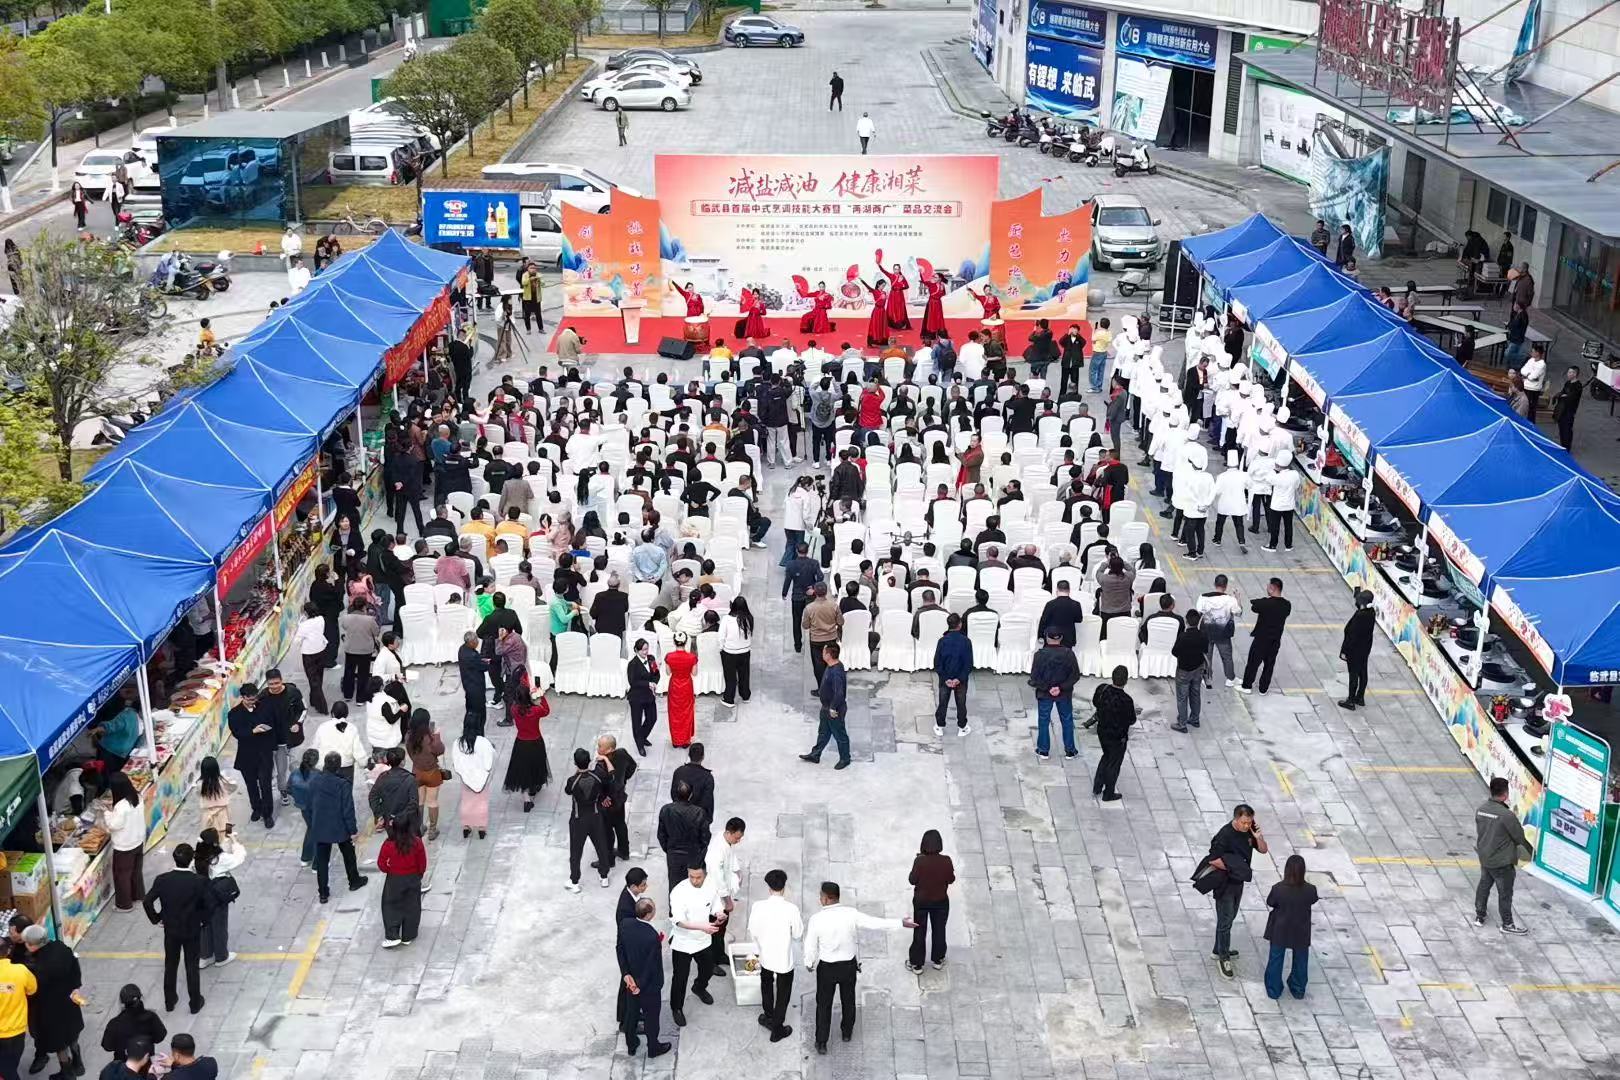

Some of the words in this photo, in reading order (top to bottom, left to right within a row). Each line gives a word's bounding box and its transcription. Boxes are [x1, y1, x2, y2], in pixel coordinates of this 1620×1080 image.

[1060, 70, 1096, 101] 来临武
[728, 168, 818, 202] 减盐减油
[832, 165, 927, 200] 健康湘菜
[1589, 670, 1620, 683] 临武县
